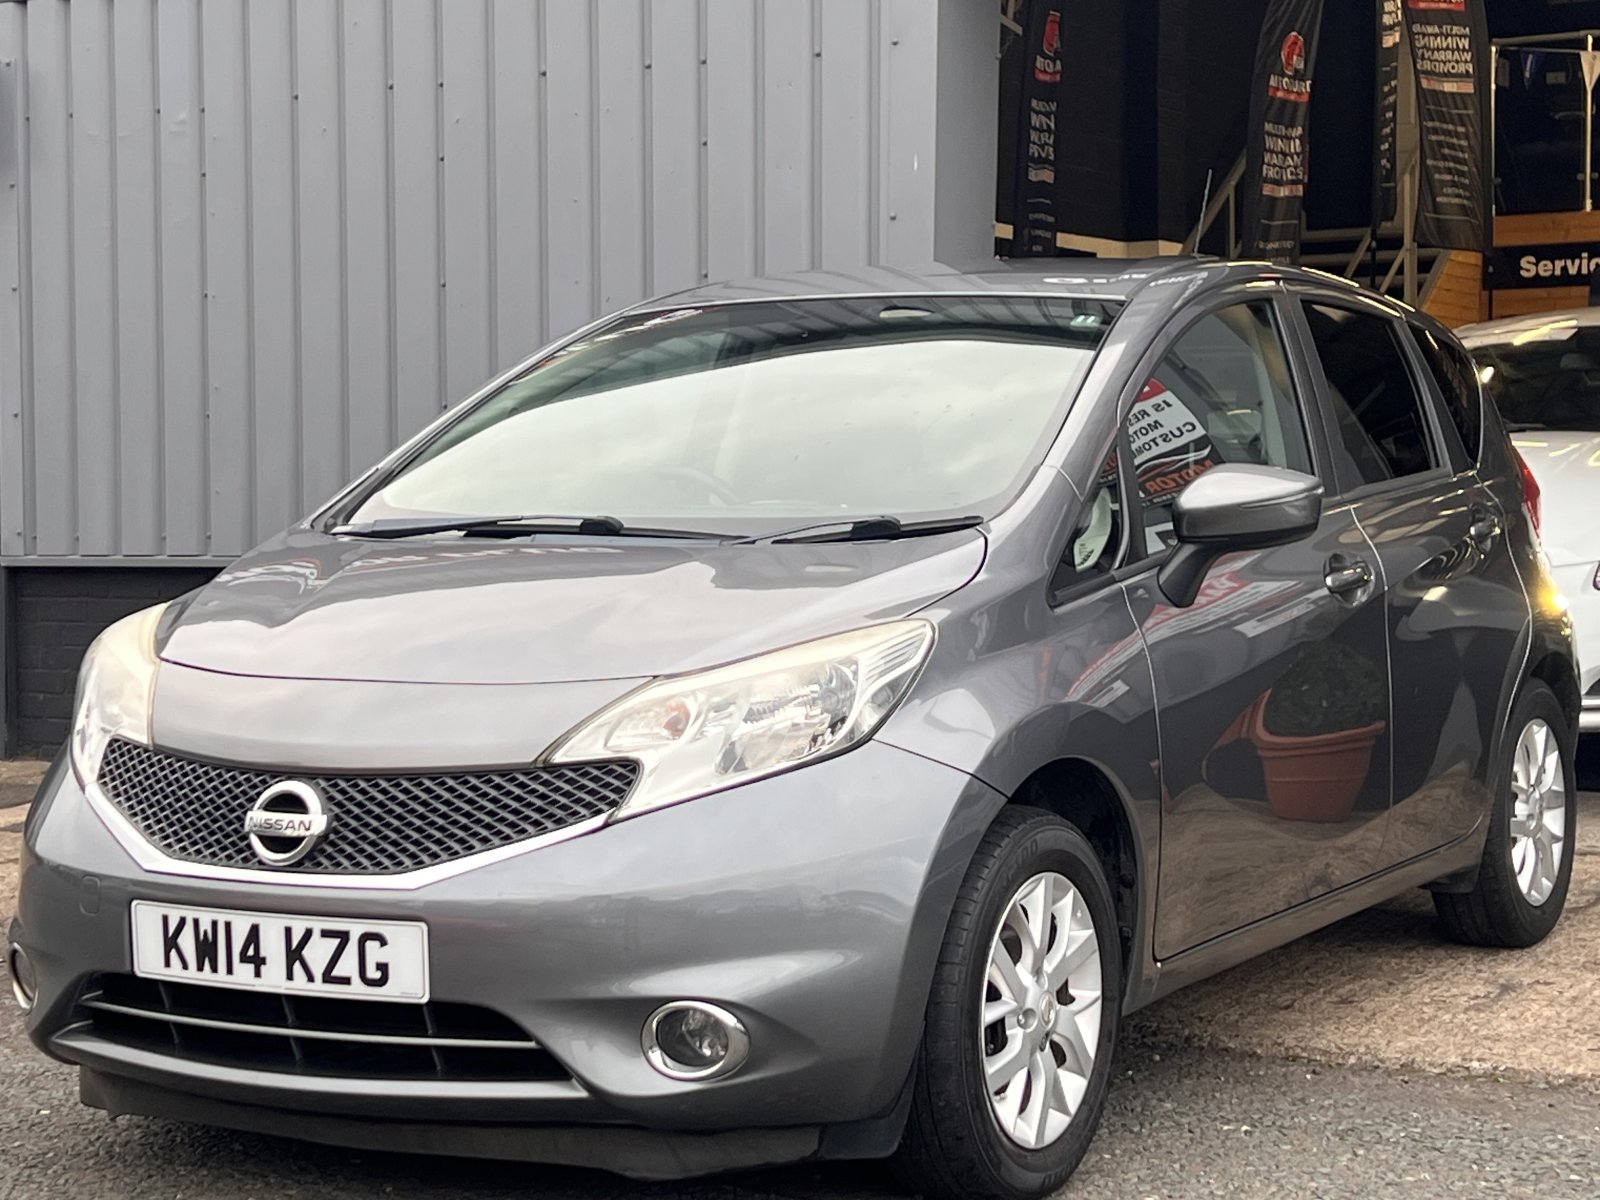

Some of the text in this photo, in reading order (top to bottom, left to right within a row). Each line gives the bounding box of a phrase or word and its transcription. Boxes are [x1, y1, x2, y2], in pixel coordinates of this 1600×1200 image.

[249, 816, 312, 832] NISSAN
[161, 913, 390, 988] KW14 KZG
